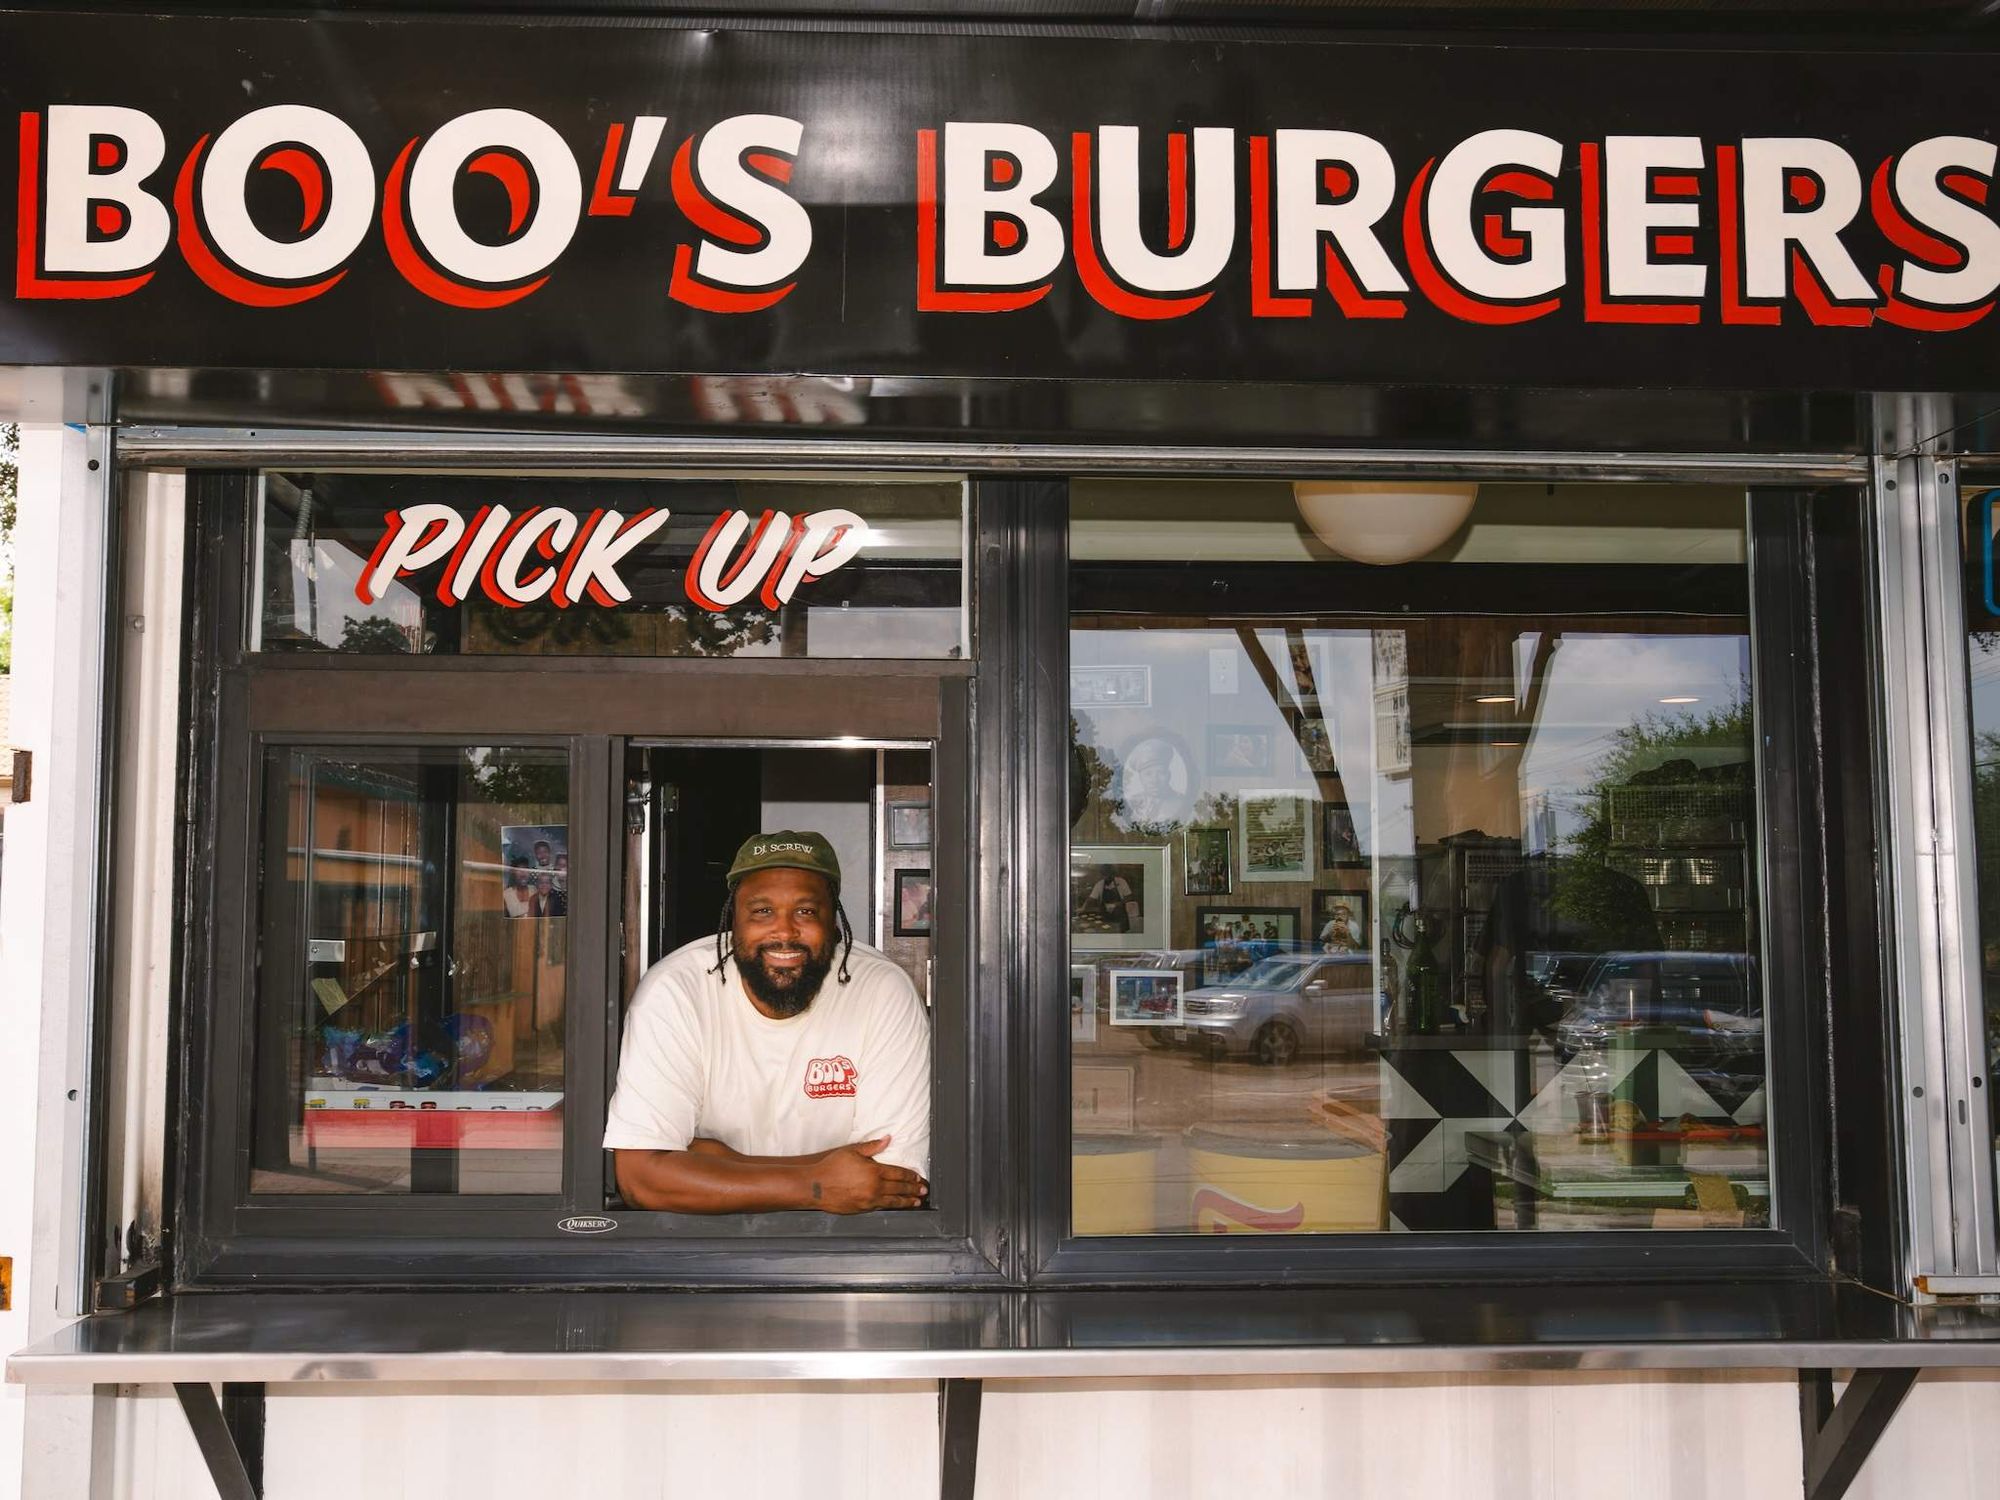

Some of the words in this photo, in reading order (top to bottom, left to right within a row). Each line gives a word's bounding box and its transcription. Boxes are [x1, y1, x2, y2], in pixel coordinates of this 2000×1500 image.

[17, 104, 814, 310] BOO'S
[917, 123, 2000, 332] BURGERS
[355, 503, 670, 608] PICK
[685, 507, 868, 612] UP
[753, 845, 767, 855] DJ
[770, 843, 813, 854] SCREW
[807, 1084, 852, 1092] BURGERS
